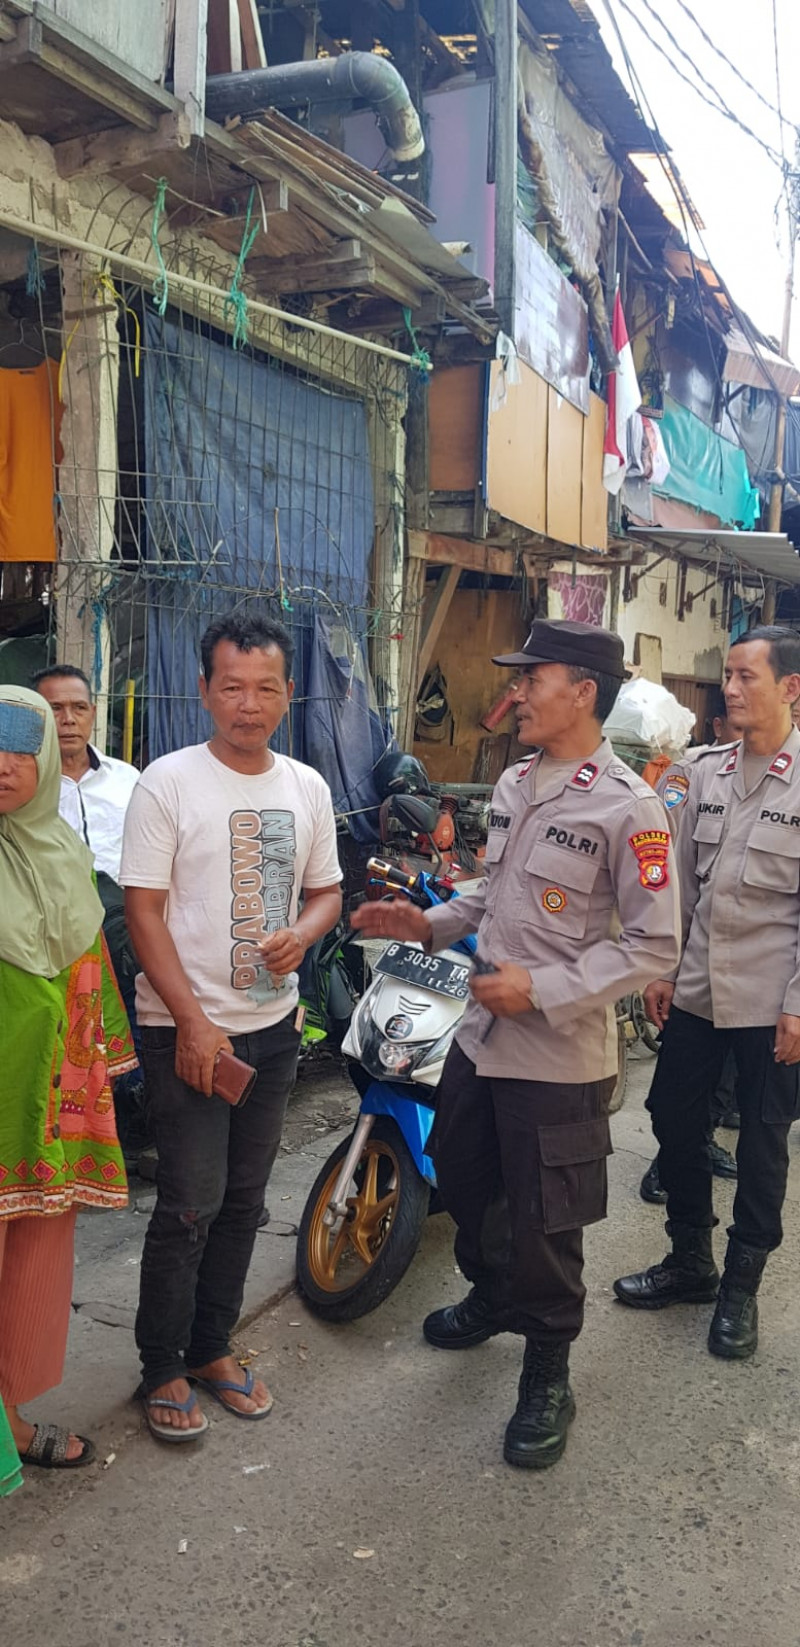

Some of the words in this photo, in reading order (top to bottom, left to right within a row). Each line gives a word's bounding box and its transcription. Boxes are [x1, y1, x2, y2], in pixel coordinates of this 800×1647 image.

[545, 825, 599, 856] POLRI
[229, 809, 267, 990] PRABOWO
[387, 944, 400, 956] B
[403, 950, 441, 972] 3035
[449, 964, 469, 982] TR
